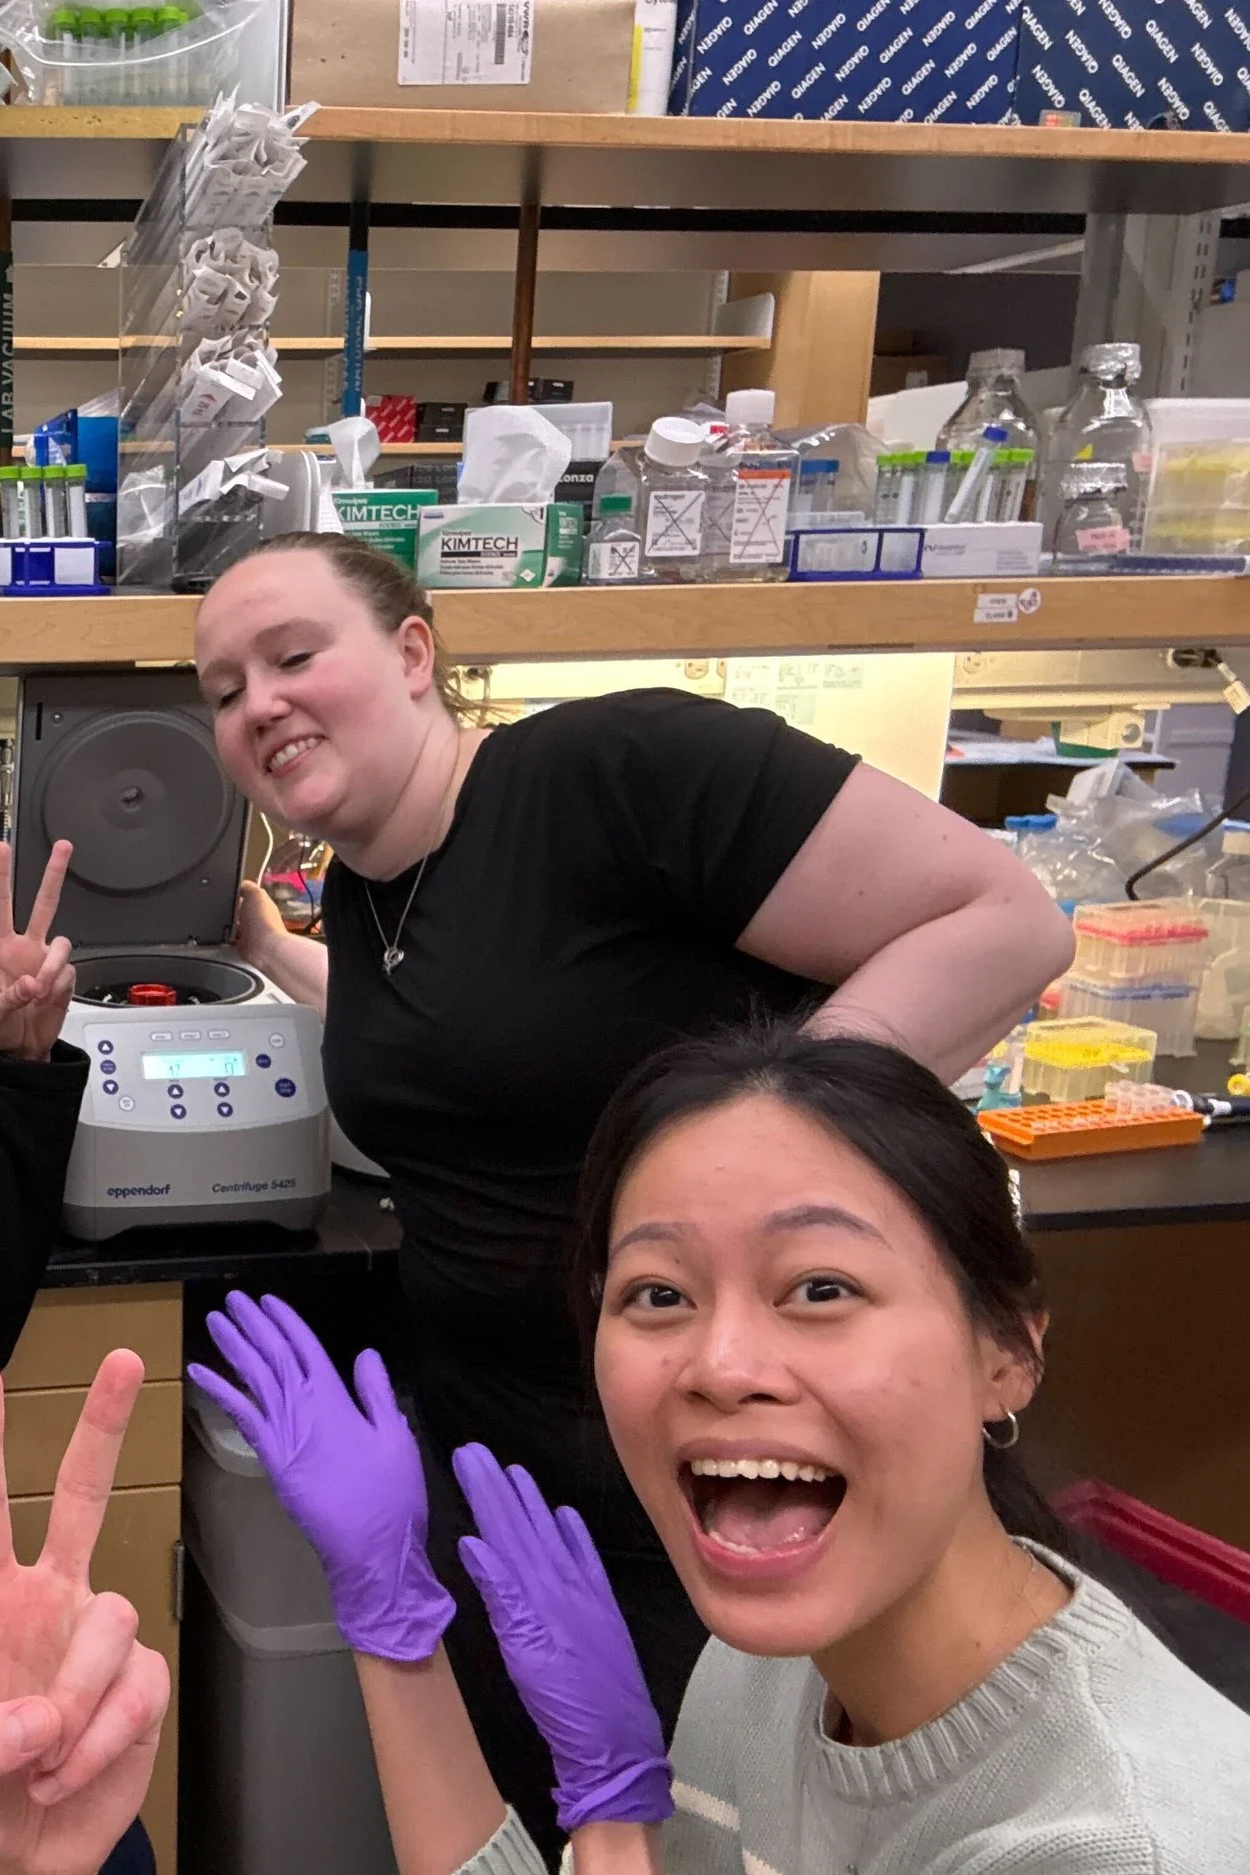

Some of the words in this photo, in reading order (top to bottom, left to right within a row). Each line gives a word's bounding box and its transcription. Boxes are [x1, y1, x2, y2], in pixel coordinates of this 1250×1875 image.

[697, 16, 732, 54] QIAGEN
[744, 0, 779, 35] QIAGEN
[812, 13, 846, 49] QIAGEN
[922, 11, 956, 47] QIAGEN
[767, 30, 803, 67] QIAGEN
[880, 27, 913, 64] QIAGEN
[987, 26, 1017, 61] QIAGEN
[1065, 30, 1098, 73] QIAGEN
[1146, 20, 1179, 63] QIAGEN
[722, 49, 757, 85] QIAGEN
[835, 45, 869, 82] QIAGEN
[902, 59, 936, 95] QIAGEN
[944, 43, 977, 78] QIAGEN
[1112, 54, 1146, 98] QIAGEN
[1191, 42, 1223, 86] QIAGEN
[791, 62, 827, 99] QIAGEN
[858, 77, 891, 113] QIAGEN
[966, 74, 998, 109] QIAGEN
[1032, 64, 1065, 108] QIAGEN
[1157, 77, 1189, 120] QIAGEN
[746, 81, 781, 117] QIAGEN
[335, 504, 420, 521] KIMTECH
[441, 537, 518, 551] KIMTECH
[107, 1184, 170, 1198] eppendorf
[212, 1182, 268, 1194] Centrifuge
